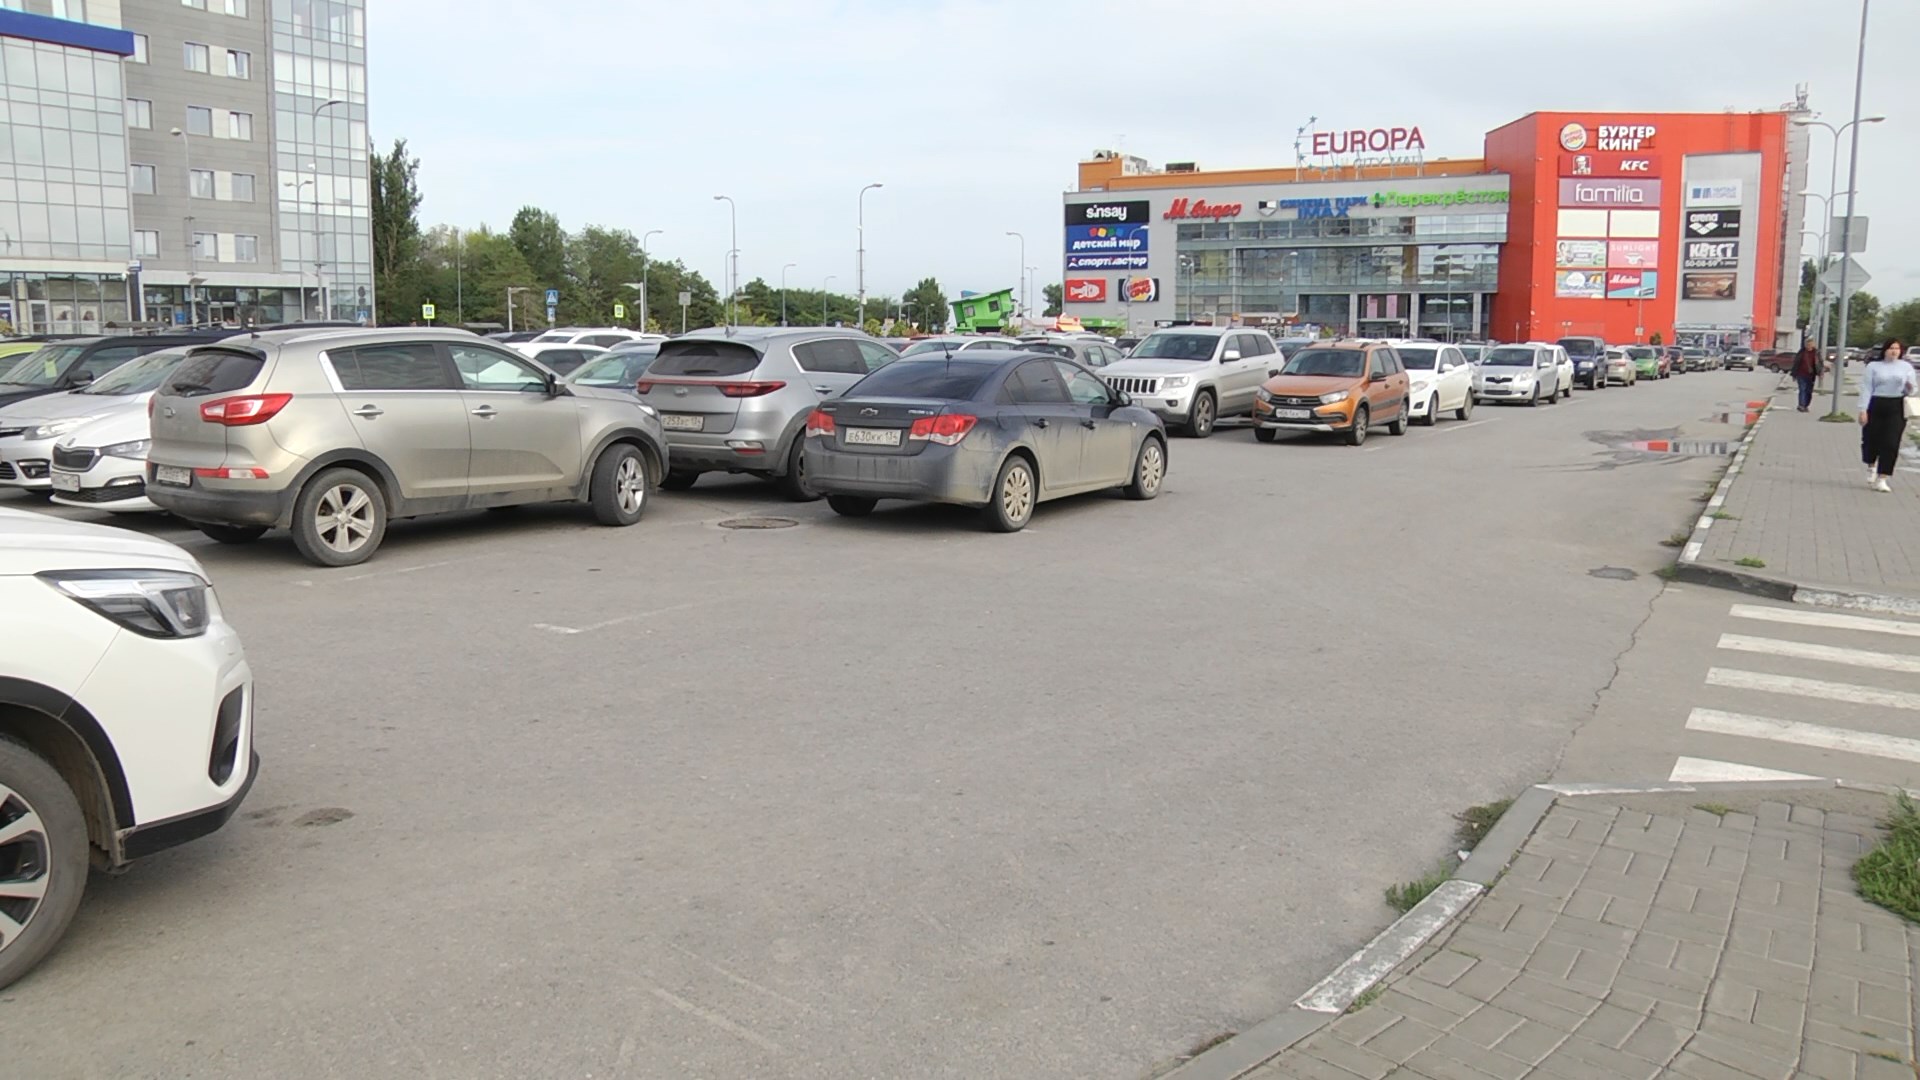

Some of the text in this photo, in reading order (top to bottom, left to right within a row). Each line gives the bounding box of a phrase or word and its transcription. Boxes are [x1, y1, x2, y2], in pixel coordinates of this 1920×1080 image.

[1598, 126, 1656, 138] БУРГЕР
[1313, 127, 1425, 155] EUROPA
[1598, 138, 1642, 150] КИНГ
[1620, 160, 1649, 171] KFC
[1575, 183, 1643, 202] familia
[1086, 204, 1127, 221] sinsay
[1297, 207, 1350, 219] IMAX
[1072, 237, 1141, 250] детский мир
